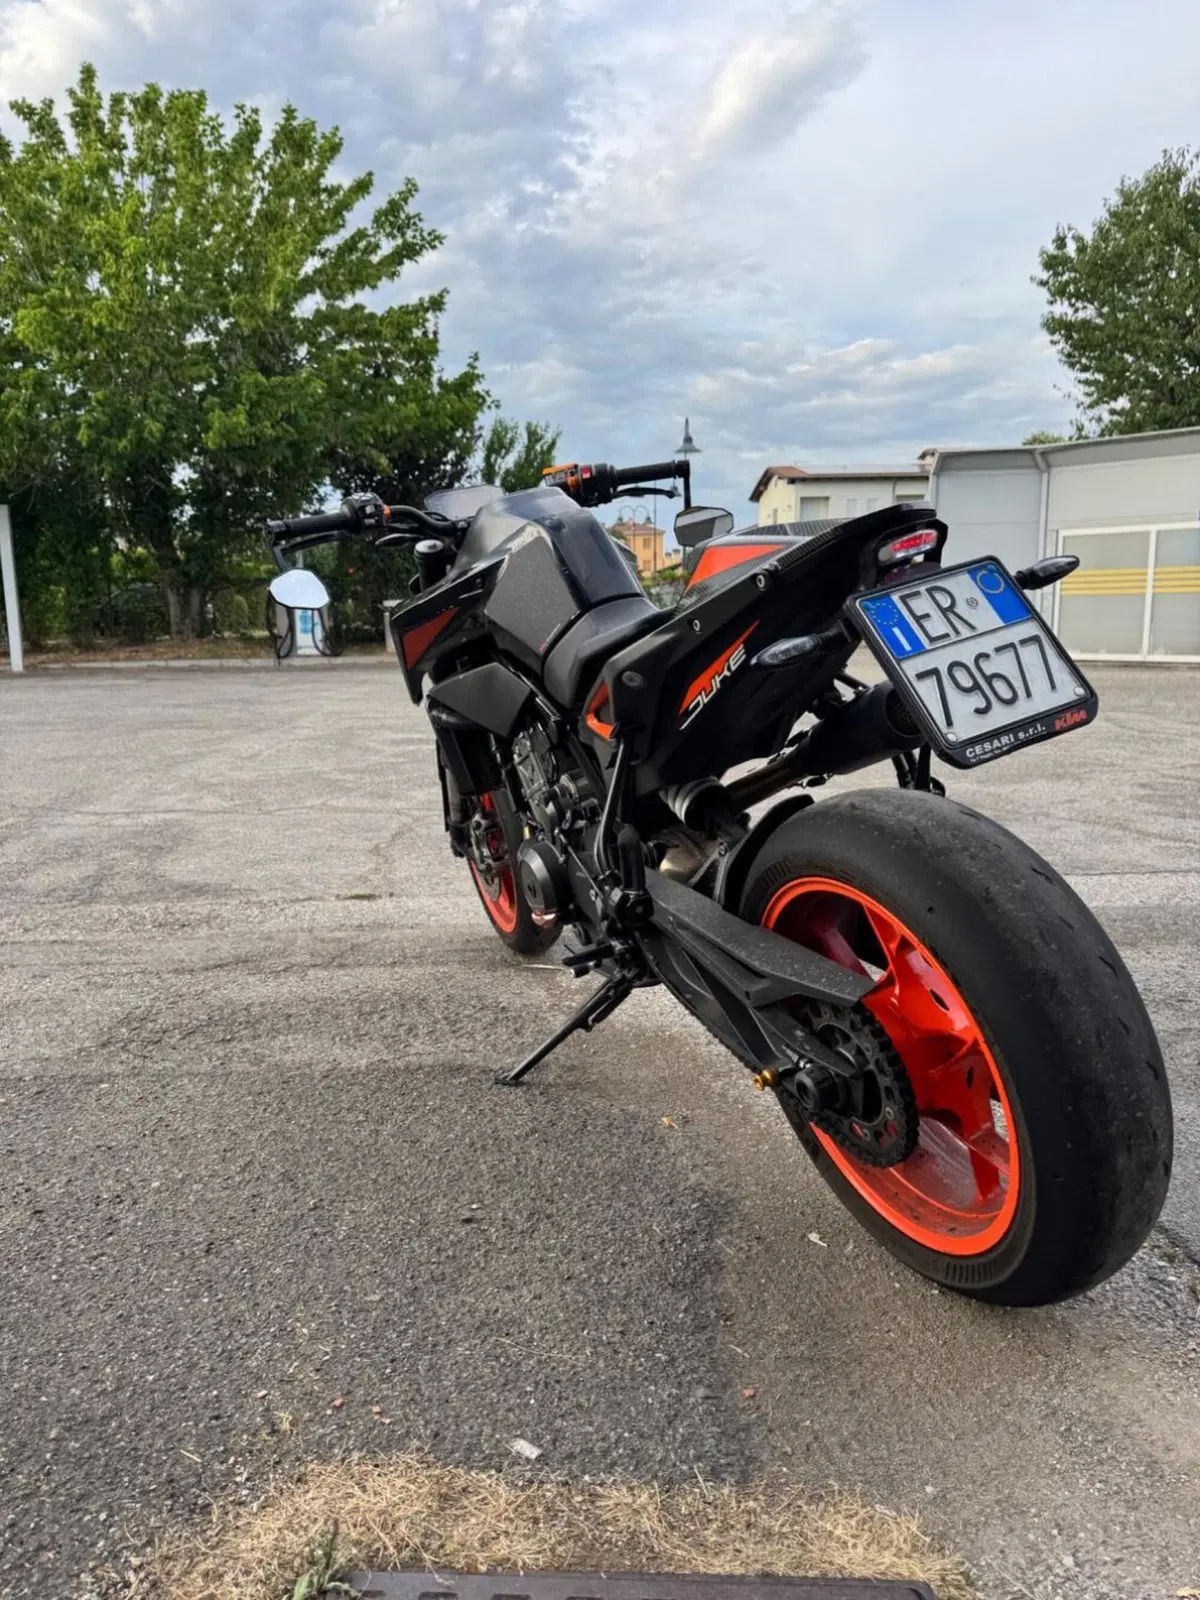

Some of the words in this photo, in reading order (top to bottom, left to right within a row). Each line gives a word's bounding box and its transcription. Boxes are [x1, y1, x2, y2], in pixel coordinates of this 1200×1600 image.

[899, 585, 977, 644] ER
[679, 643, 747, 731] DUKE
[915, 634, 1058, 728] 79677
[966, 733, 1015, 758] CESARI
[1017, 723, 1047, 740] s.r.l.
[1053, 708, 1087, 731] KTM
